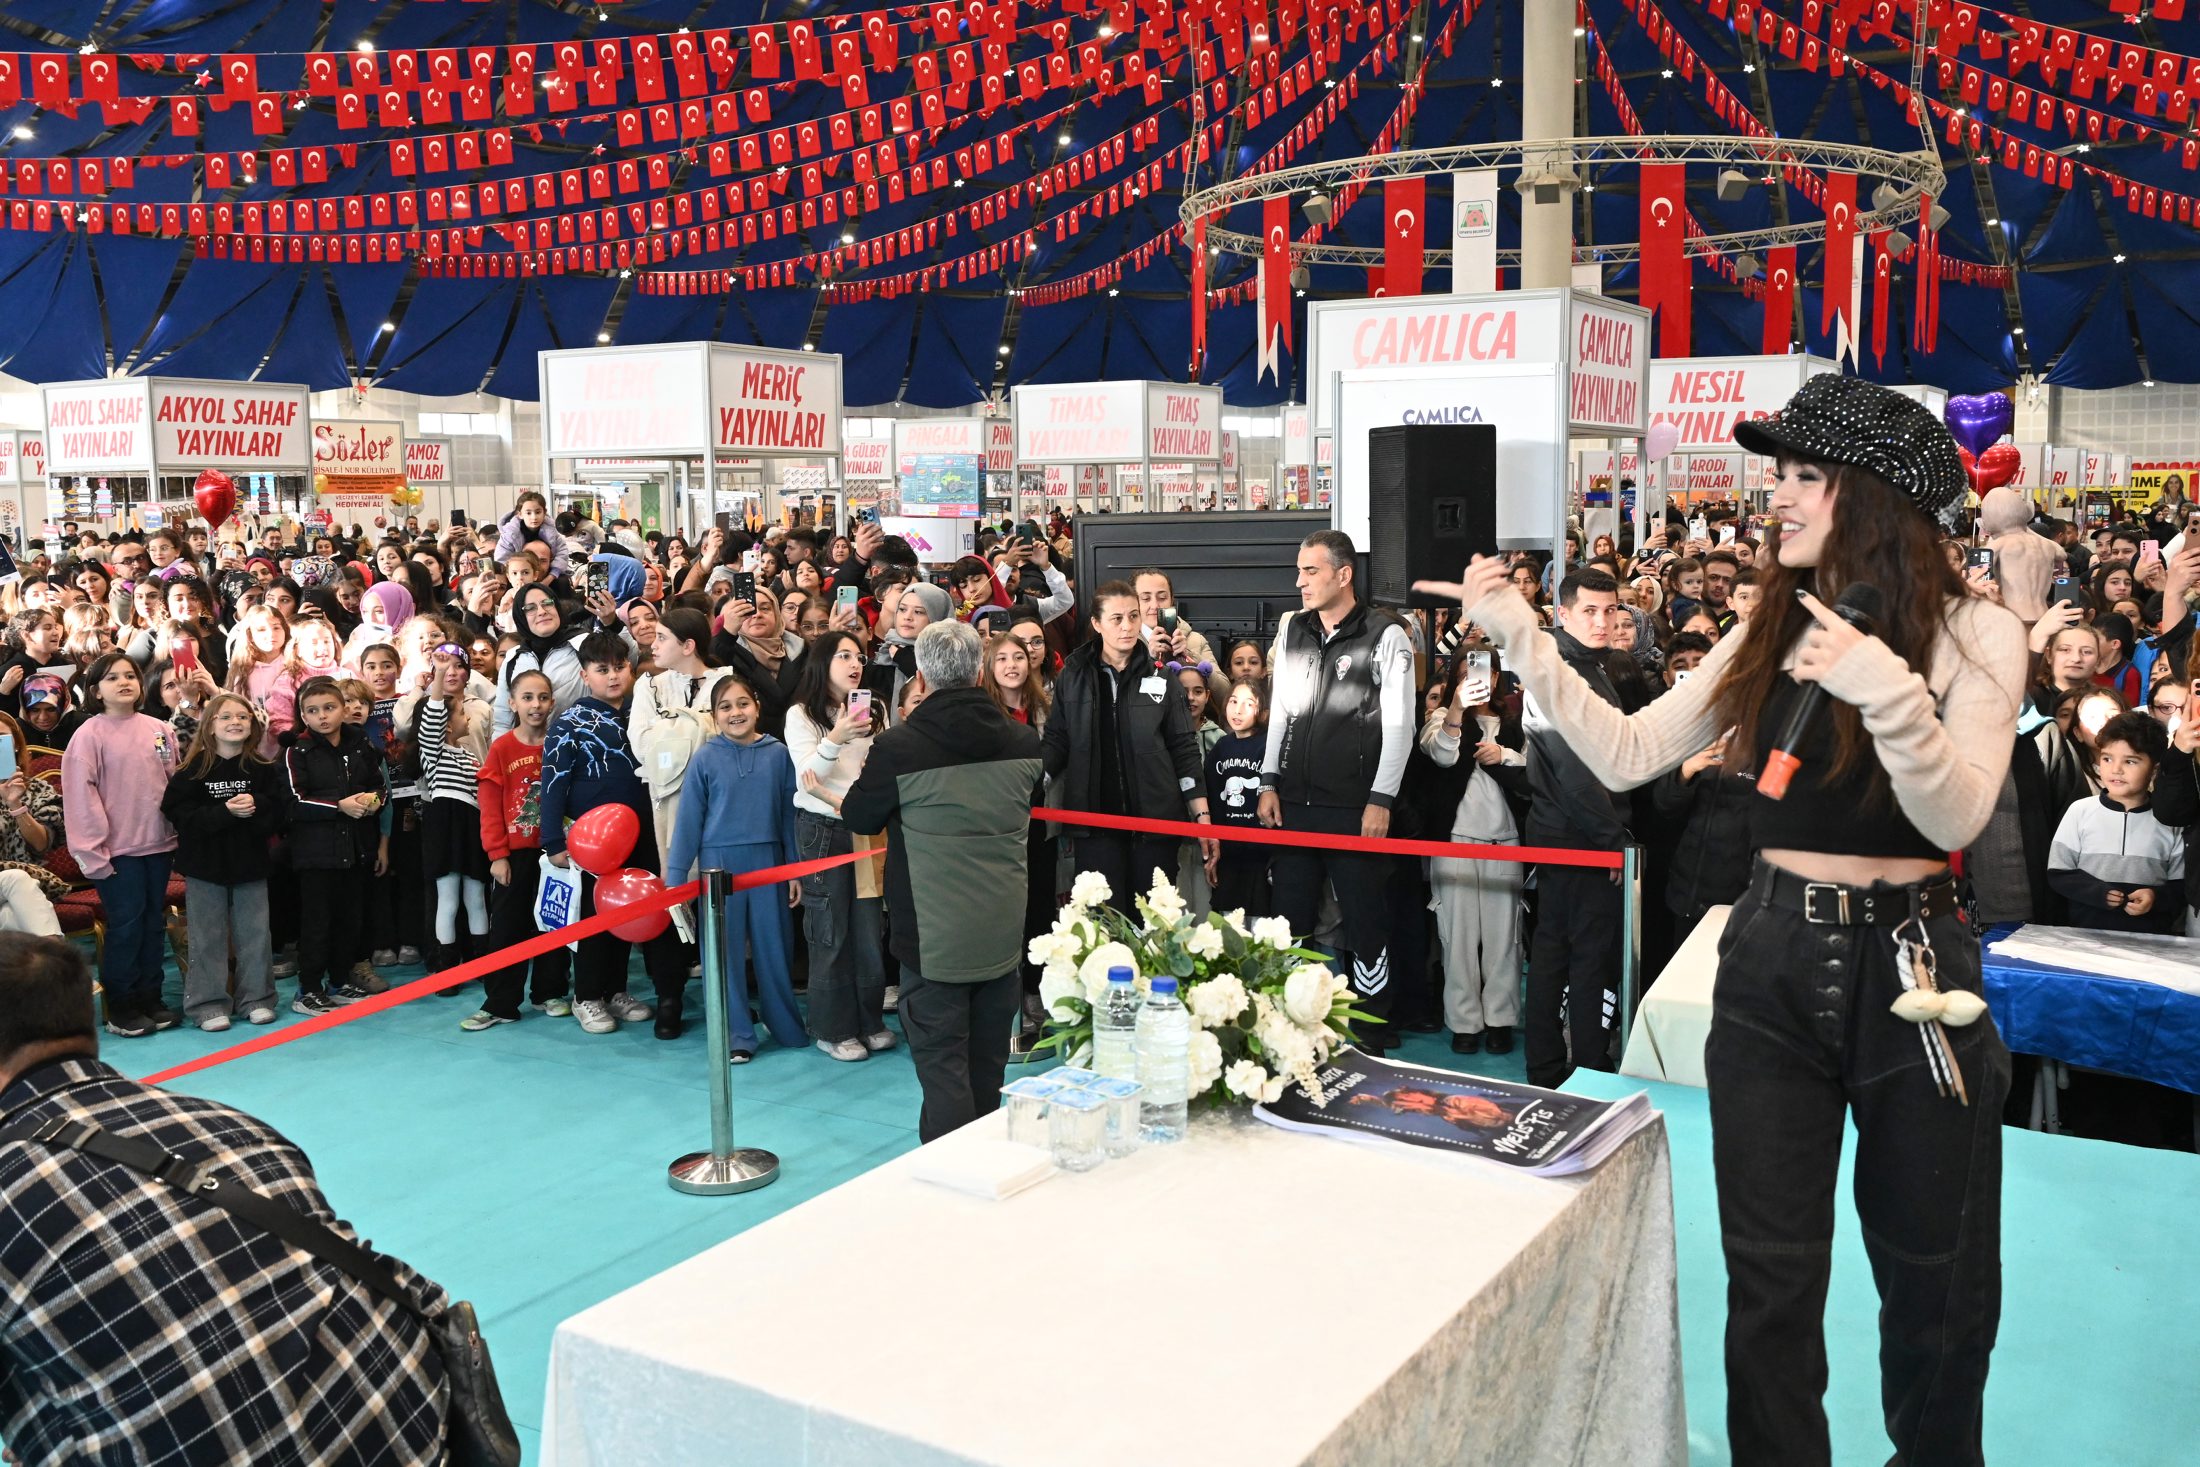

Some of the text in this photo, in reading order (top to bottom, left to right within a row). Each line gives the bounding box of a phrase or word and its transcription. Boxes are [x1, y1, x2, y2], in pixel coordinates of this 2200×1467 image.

[1353, 311, 1516, 369] ÇAMLICA
[1579, 312, 1633, 368] ÇAMLICA
[741, 361, 805, 407] MERİÇ
[1571, 372, 1637, 425] YAYINLARI
[1668, 371, 1745, 403] NESİL
[50, 397, 143, 427] AKYOL SAHAF
[157, 396, 298, 426] AKYOL SAHAF
[1166, 395, 1200, 426] TİMAŞ
[177, 429, 282, 457] YAYINLARI
[720, 407, 826, 448] YAYINLARI
[1153, 428, 1212, 455] YAYINLARI
[63, 430, 133, 458] YAYINLARI
[314, 425, 393, 462] Sözler
[852, 443, 888, 458] GÜLBEY
[543, 902, 566, 918] ALTIN
